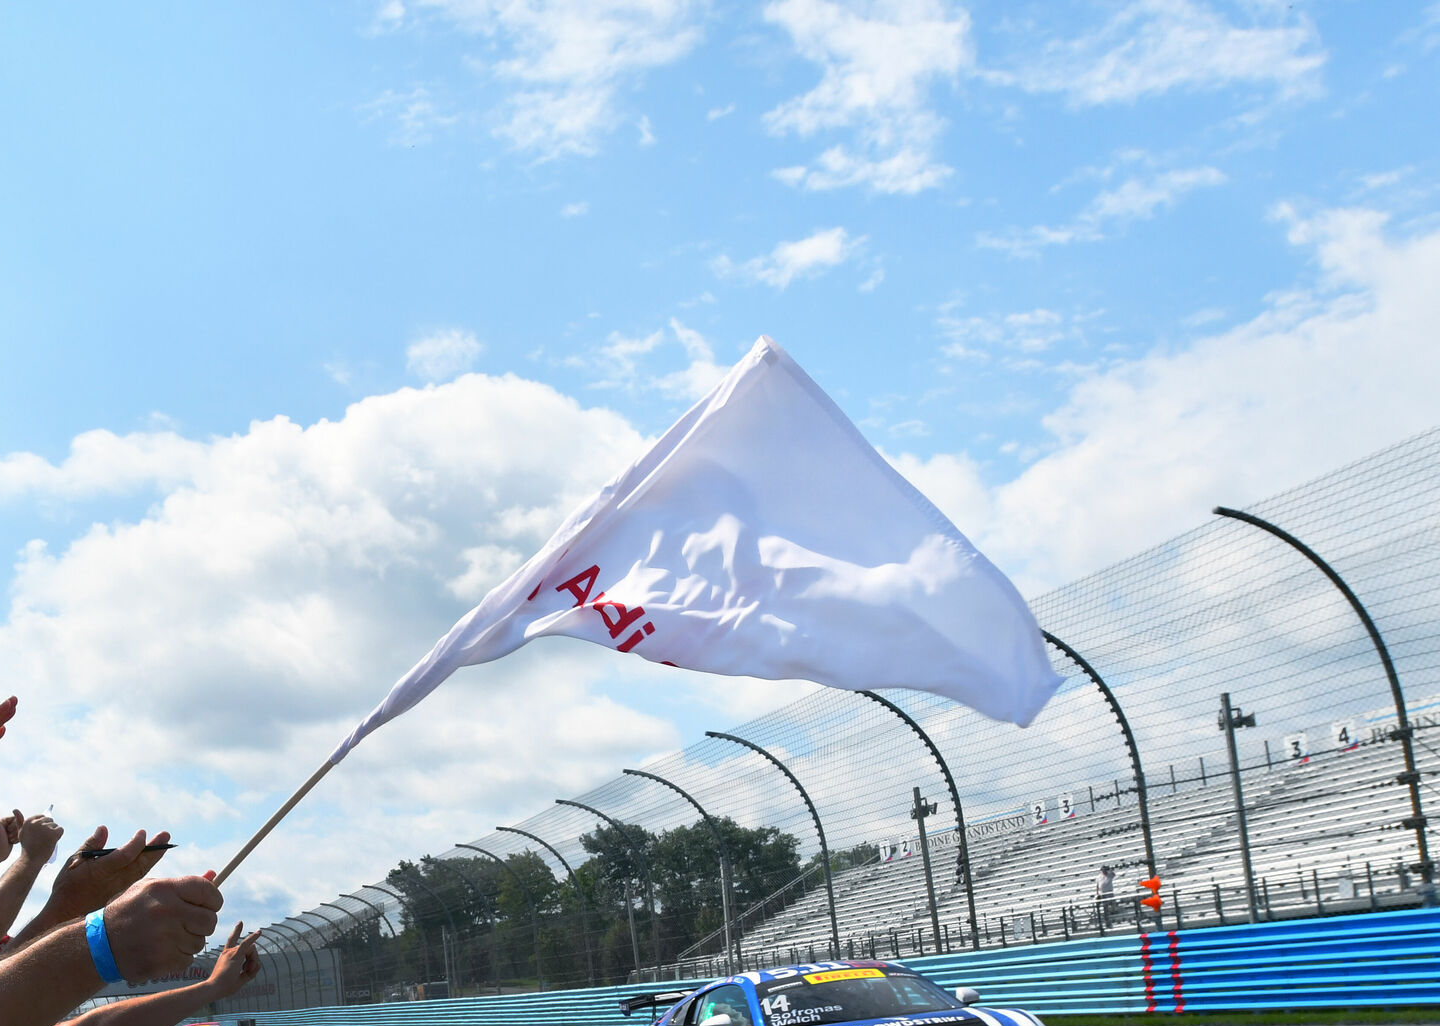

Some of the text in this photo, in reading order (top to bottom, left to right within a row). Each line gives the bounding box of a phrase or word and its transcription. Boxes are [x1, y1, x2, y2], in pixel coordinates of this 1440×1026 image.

[1338, 727, 1350, 743] 4
[1291, 741, 1301, 758] 3
[1035, 806, 1042, 819] 2
[1063, 799, 1070, 814] 3
[914, 816, 1025, 851] BDINE GANDSTAND
[902, 841, 908, 852] 2
[767, 961, 850, 979] 5.11
[761, 994, 791, 1016] 14
[770, 1003, 843, 1021] Sofronas
[771, 1014, 821, 1026] Welch
